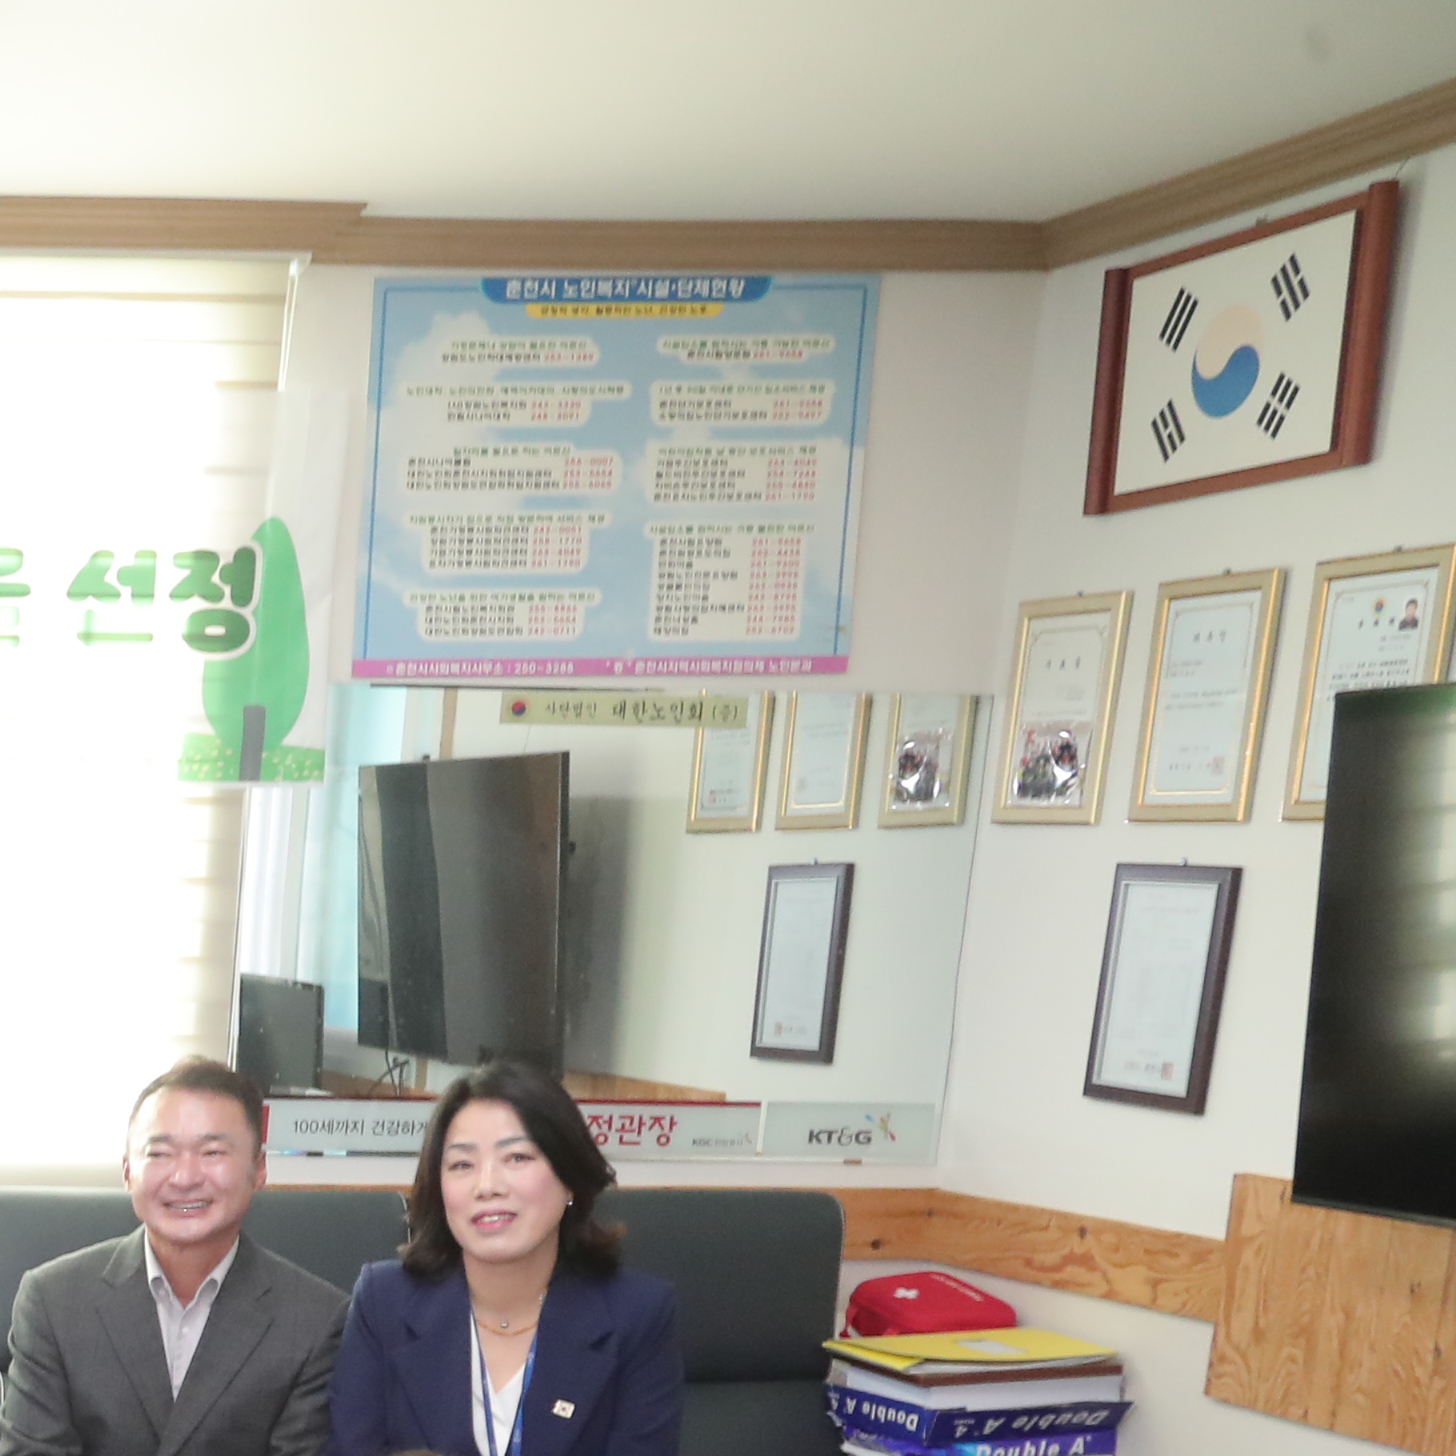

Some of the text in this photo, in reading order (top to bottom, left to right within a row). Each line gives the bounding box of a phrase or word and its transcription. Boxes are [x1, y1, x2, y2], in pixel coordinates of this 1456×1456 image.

[67, 547, 256, 653] 선정
[611, 698, 704, 725] 대한노인회
[294, 1118, 365, 1137] 100세까지
[586, 1113, 679, 1148] 정관장
[806, 1128, 873, 1147] KT&G
[861, 1396, 920, 1433] Double
[1012, 1408, 1110, 1431] Double
[1069, 1438, 1089, 1456] A
